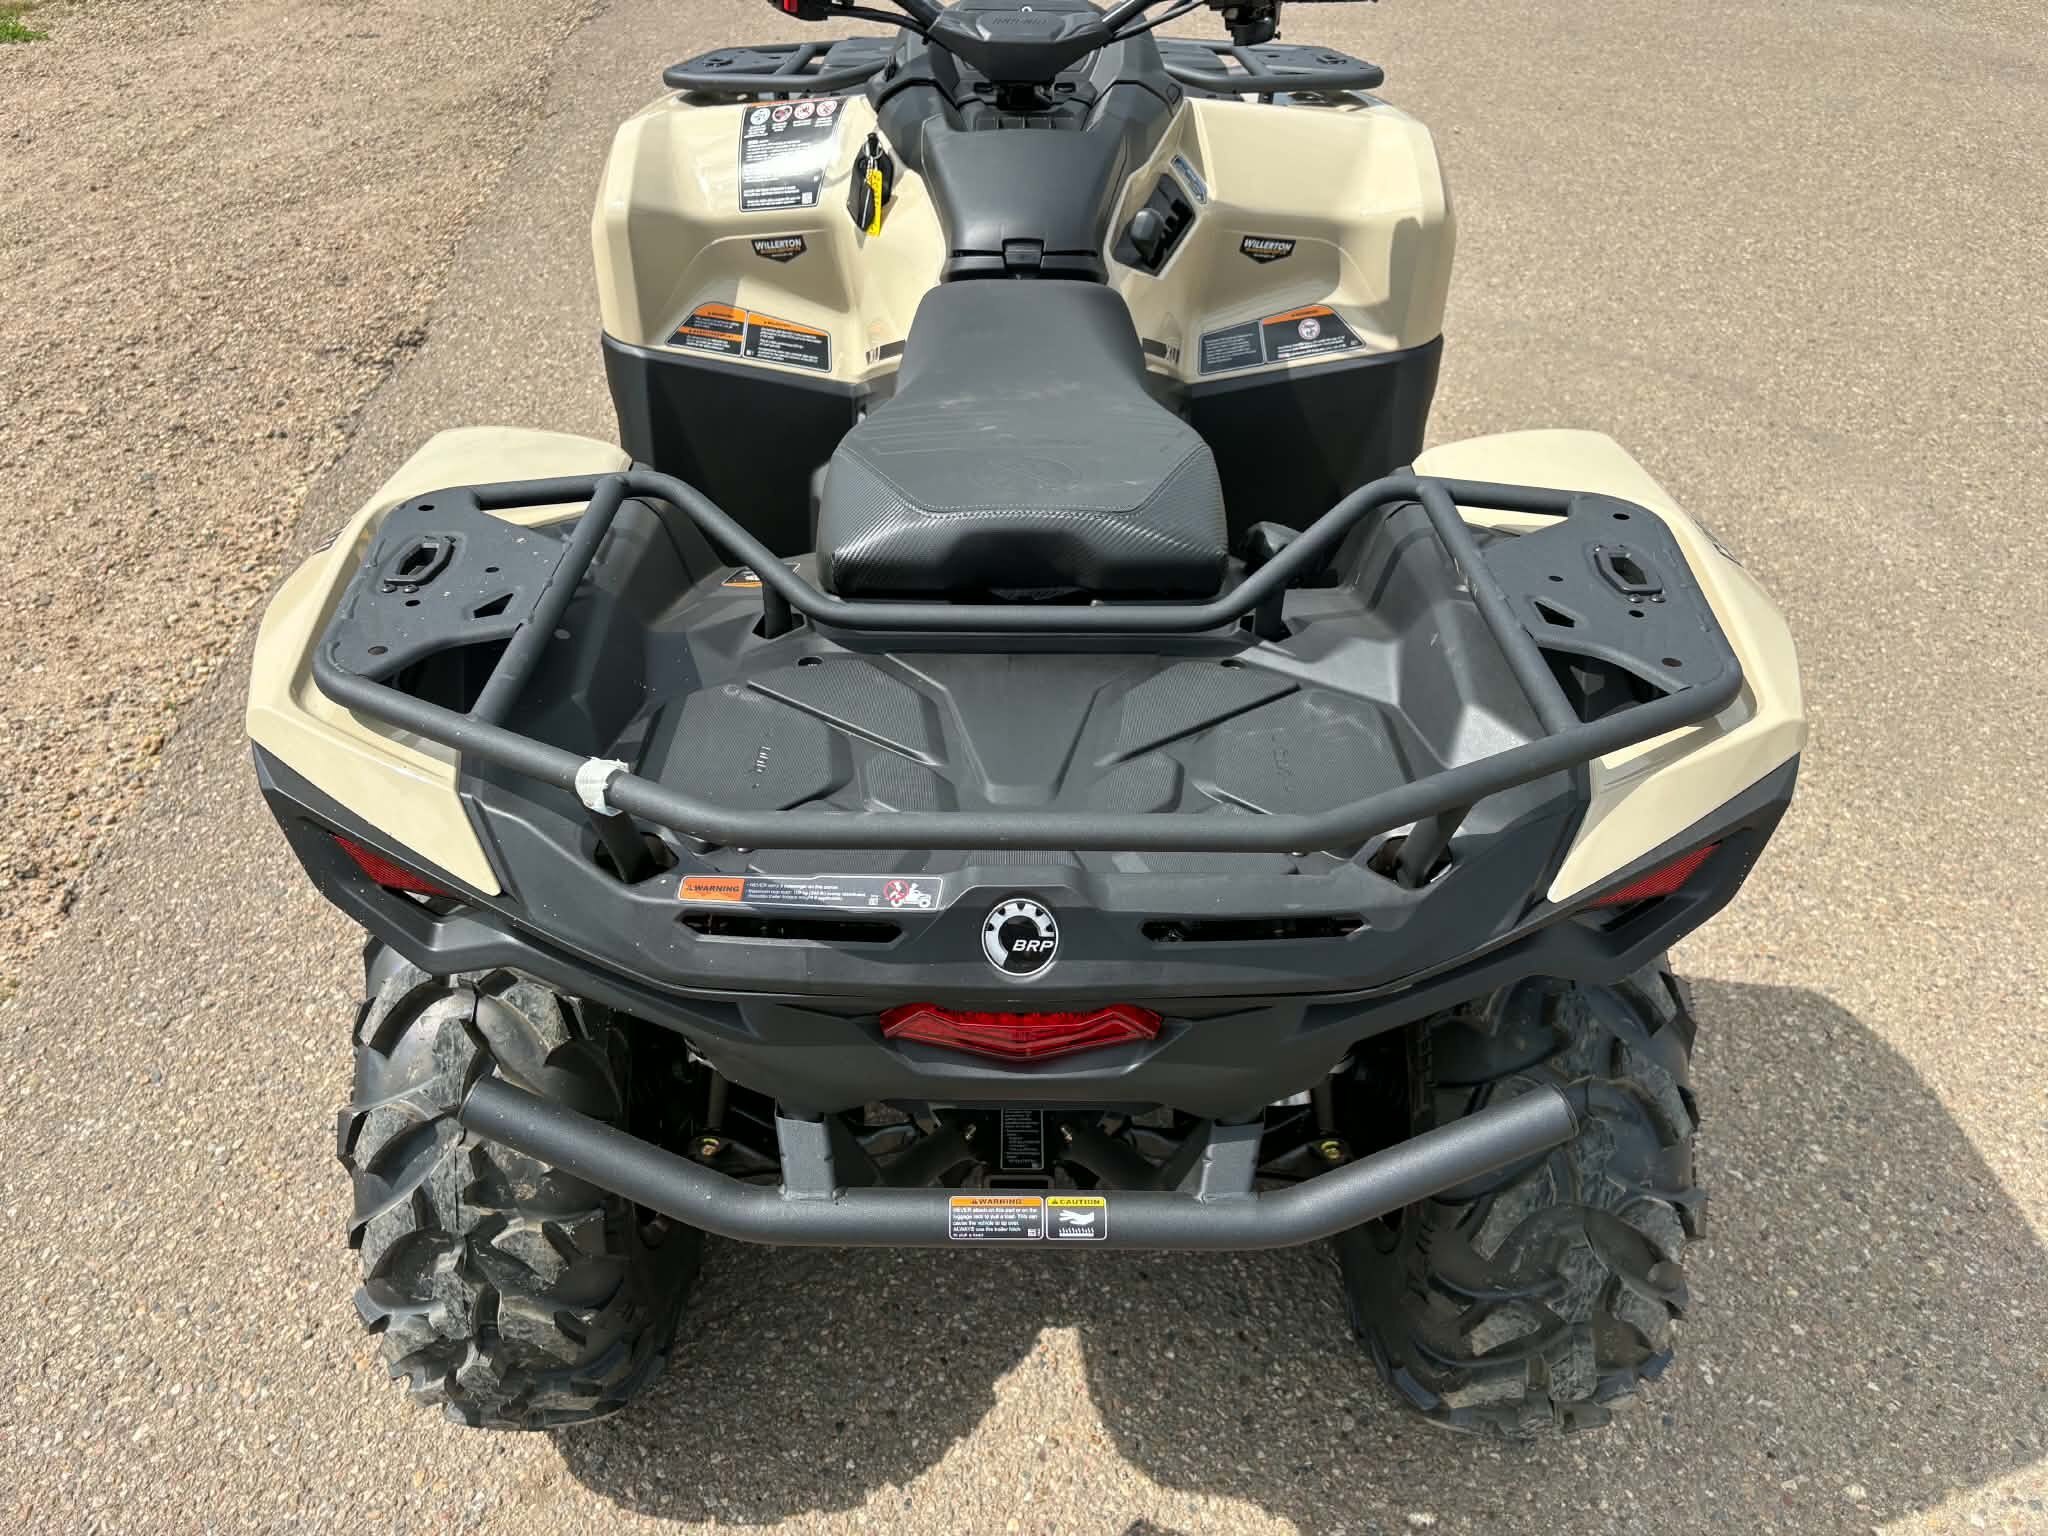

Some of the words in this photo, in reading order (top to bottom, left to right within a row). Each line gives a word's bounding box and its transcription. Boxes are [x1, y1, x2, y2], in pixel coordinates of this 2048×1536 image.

[755, 238, 801, 250] WILLERTON
[1244, 239, 1292, 250] WILLERTON
[695, 885, 740, 893] WARNING
[1012, 939, 1055, 952] BRP
